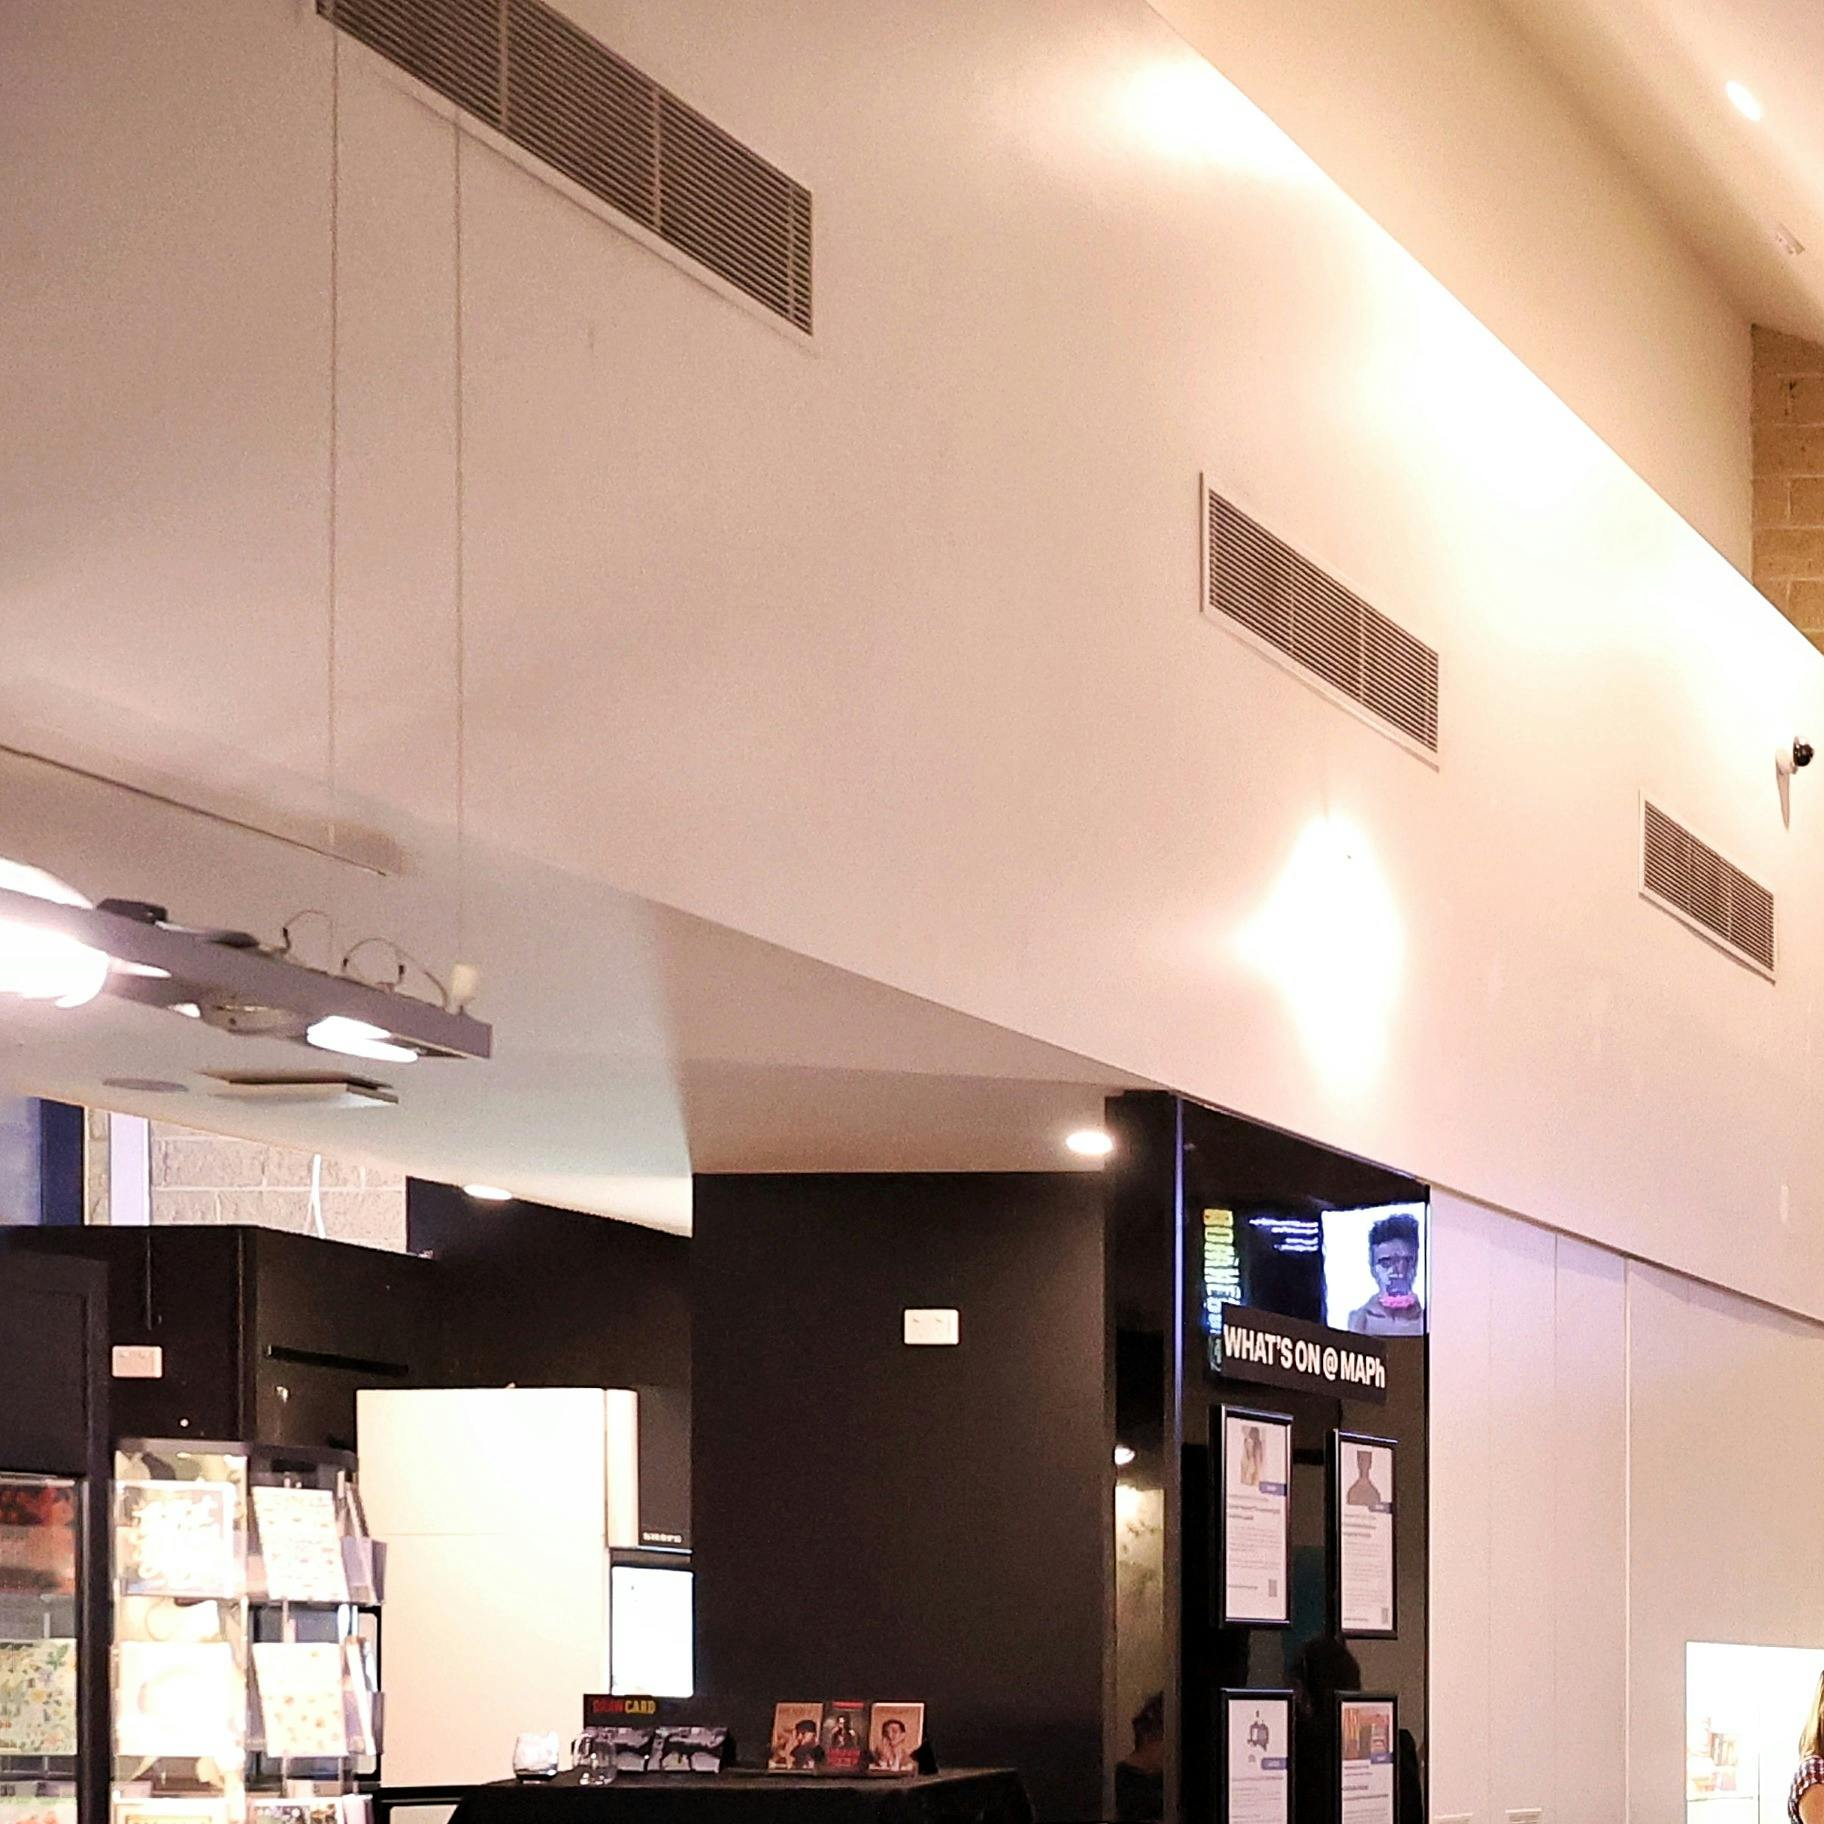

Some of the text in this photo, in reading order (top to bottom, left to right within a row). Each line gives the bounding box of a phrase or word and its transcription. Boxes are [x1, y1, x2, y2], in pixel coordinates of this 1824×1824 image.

[1223, 1325, 1386, 1388] WHAT'S ON @ MAPh
